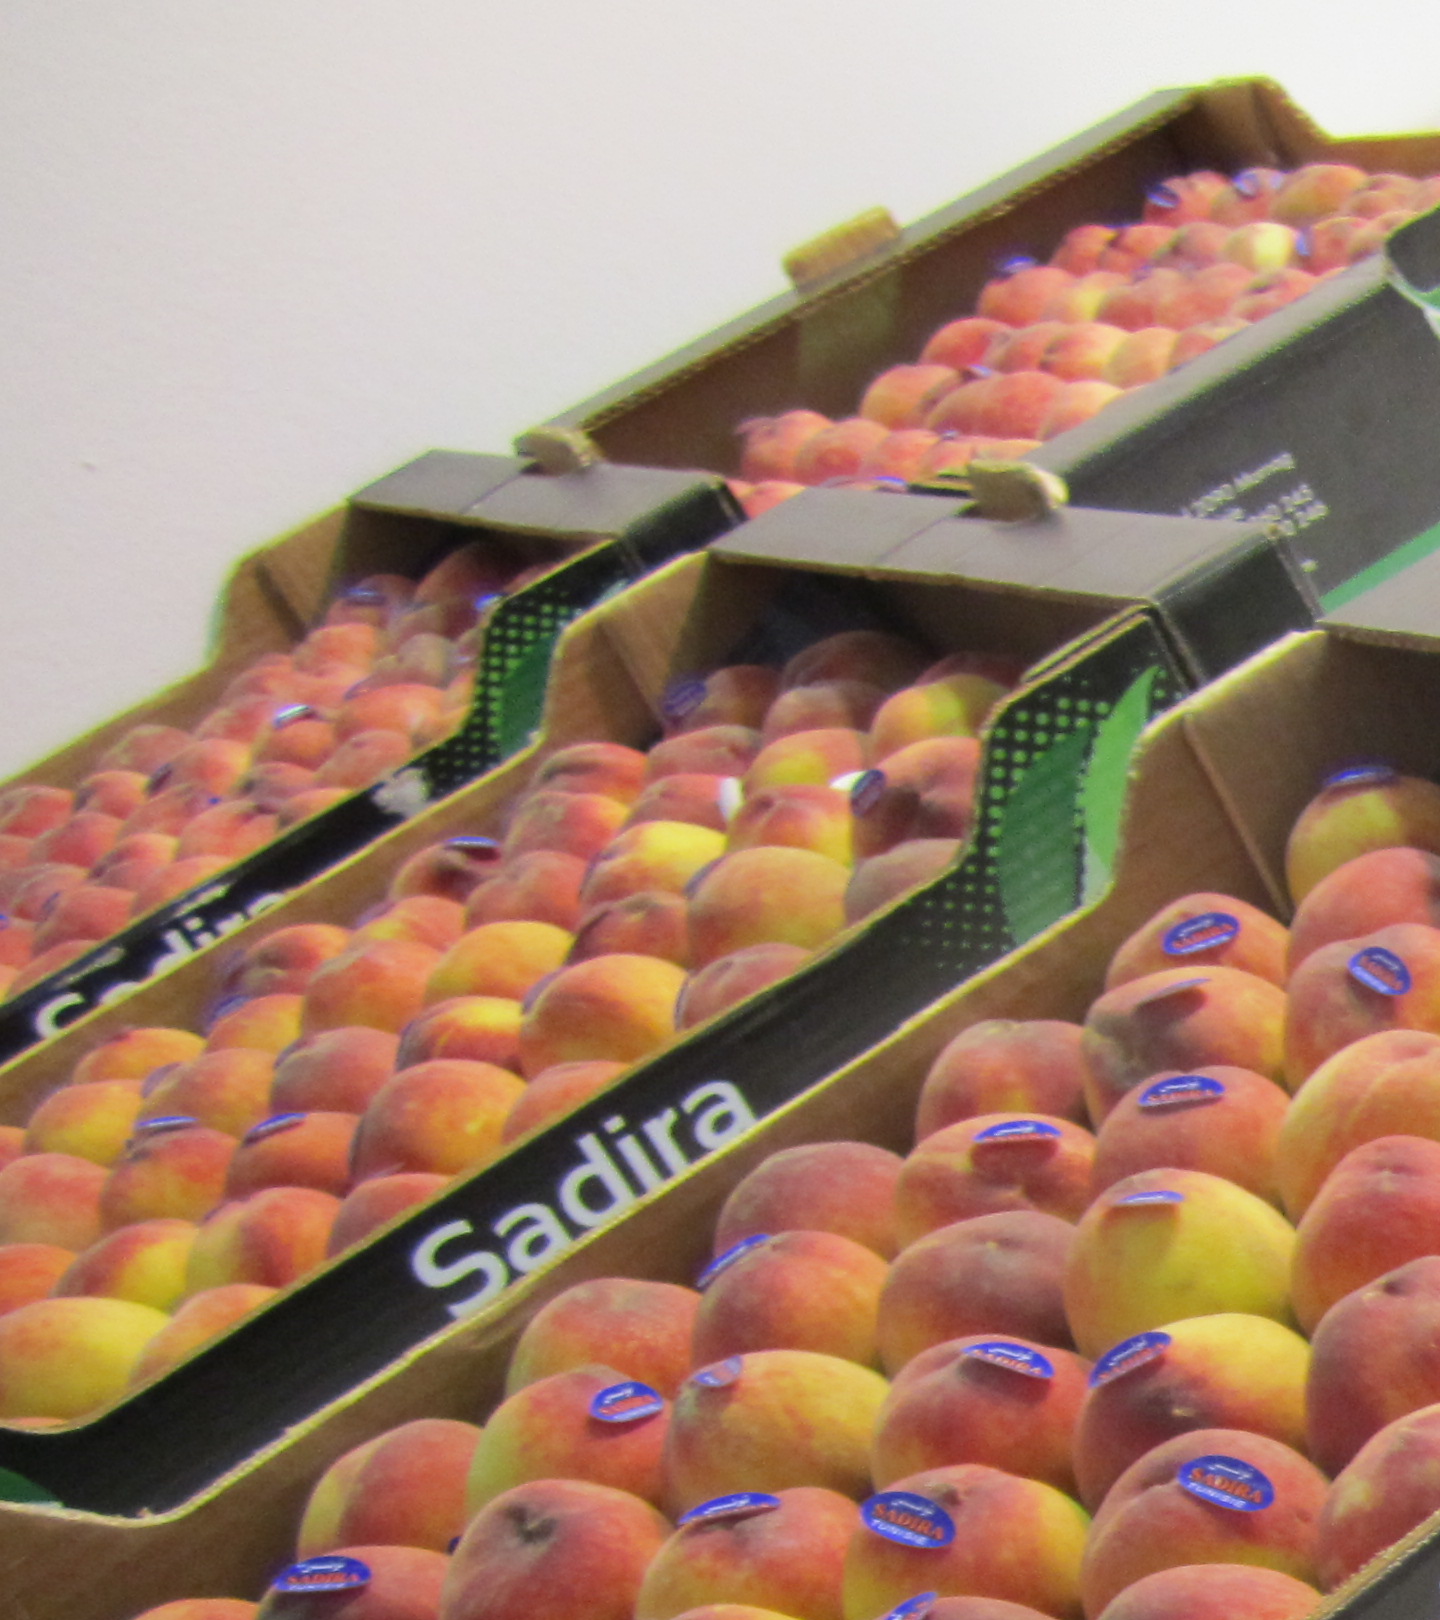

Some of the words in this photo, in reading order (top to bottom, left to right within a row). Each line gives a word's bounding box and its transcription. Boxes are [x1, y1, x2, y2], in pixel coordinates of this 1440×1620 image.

[411, 1080, 758, 1320] Sadira
[1190, 1467, 1263, 1504] SADIRA
[873, 1503, 945, 1540] SADIRA
